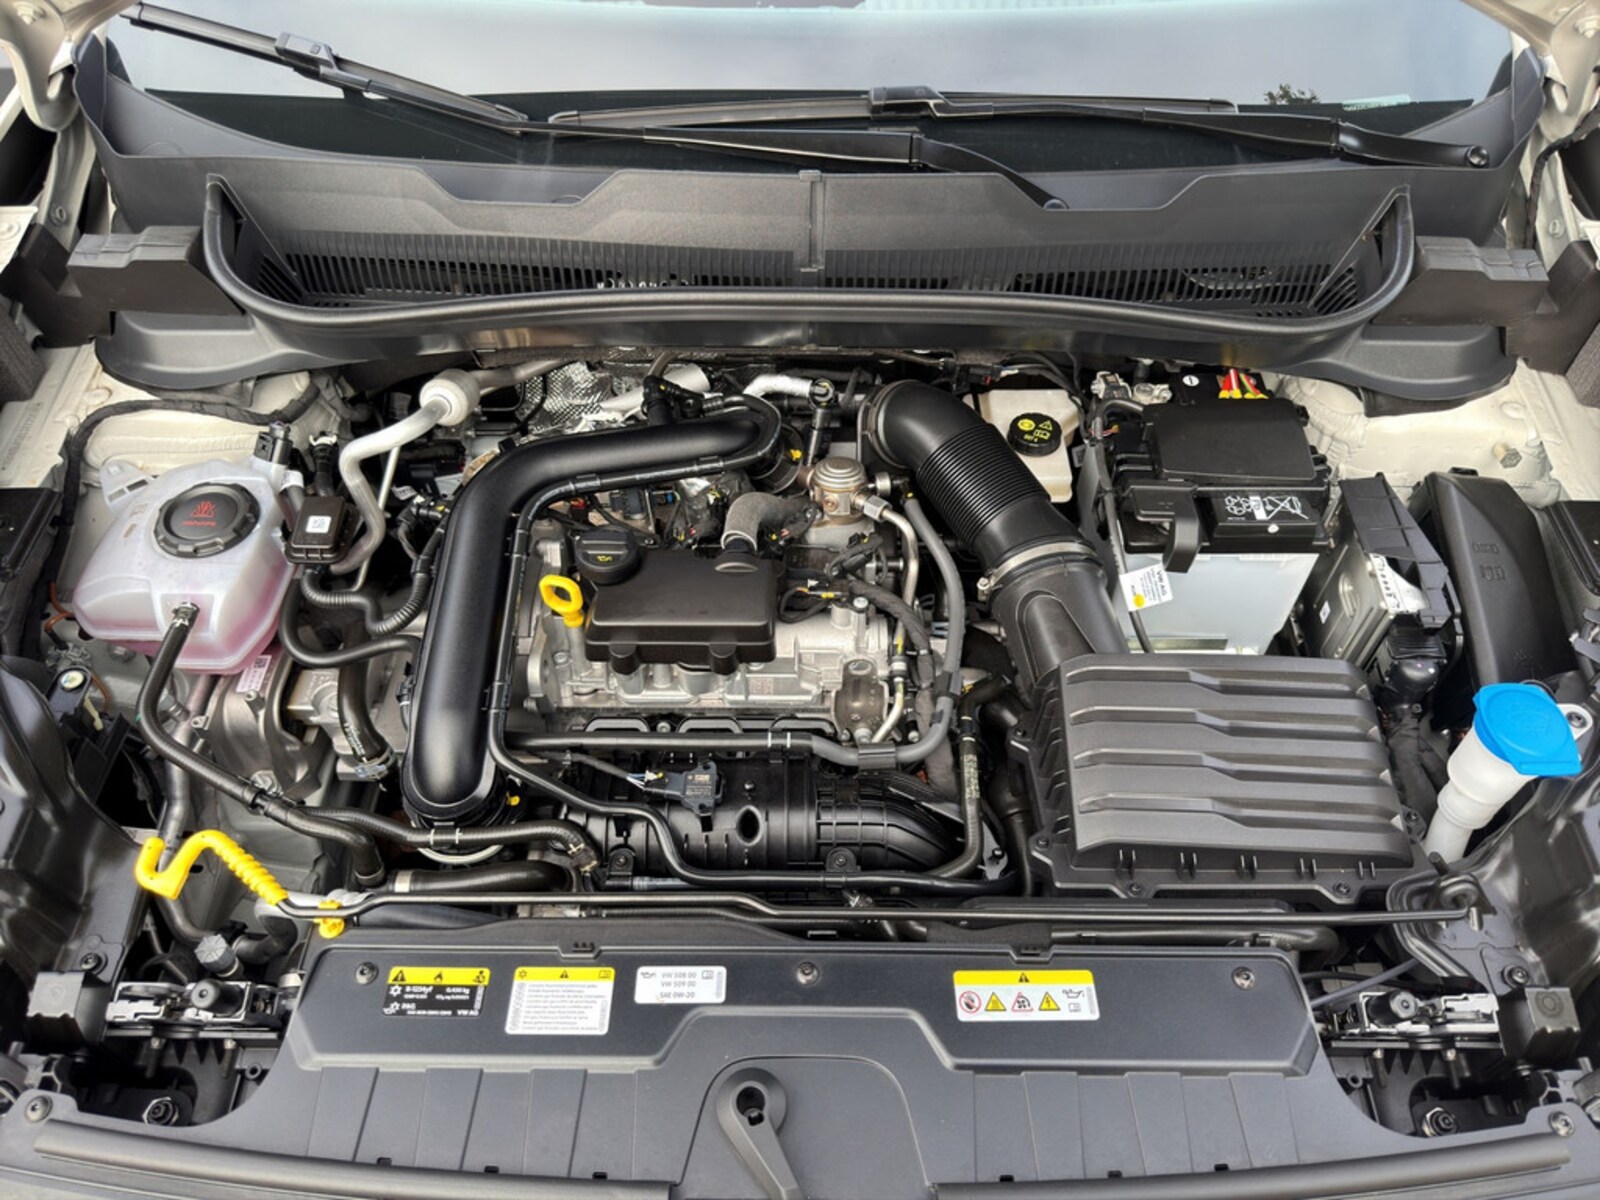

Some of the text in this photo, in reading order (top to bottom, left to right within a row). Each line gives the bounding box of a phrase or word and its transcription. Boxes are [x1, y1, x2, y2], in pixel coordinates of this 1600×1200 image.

[687, 971, 697, 979] 00
[687, 980, 697, 988] 00
[660, 991, 672, 999] SAE
